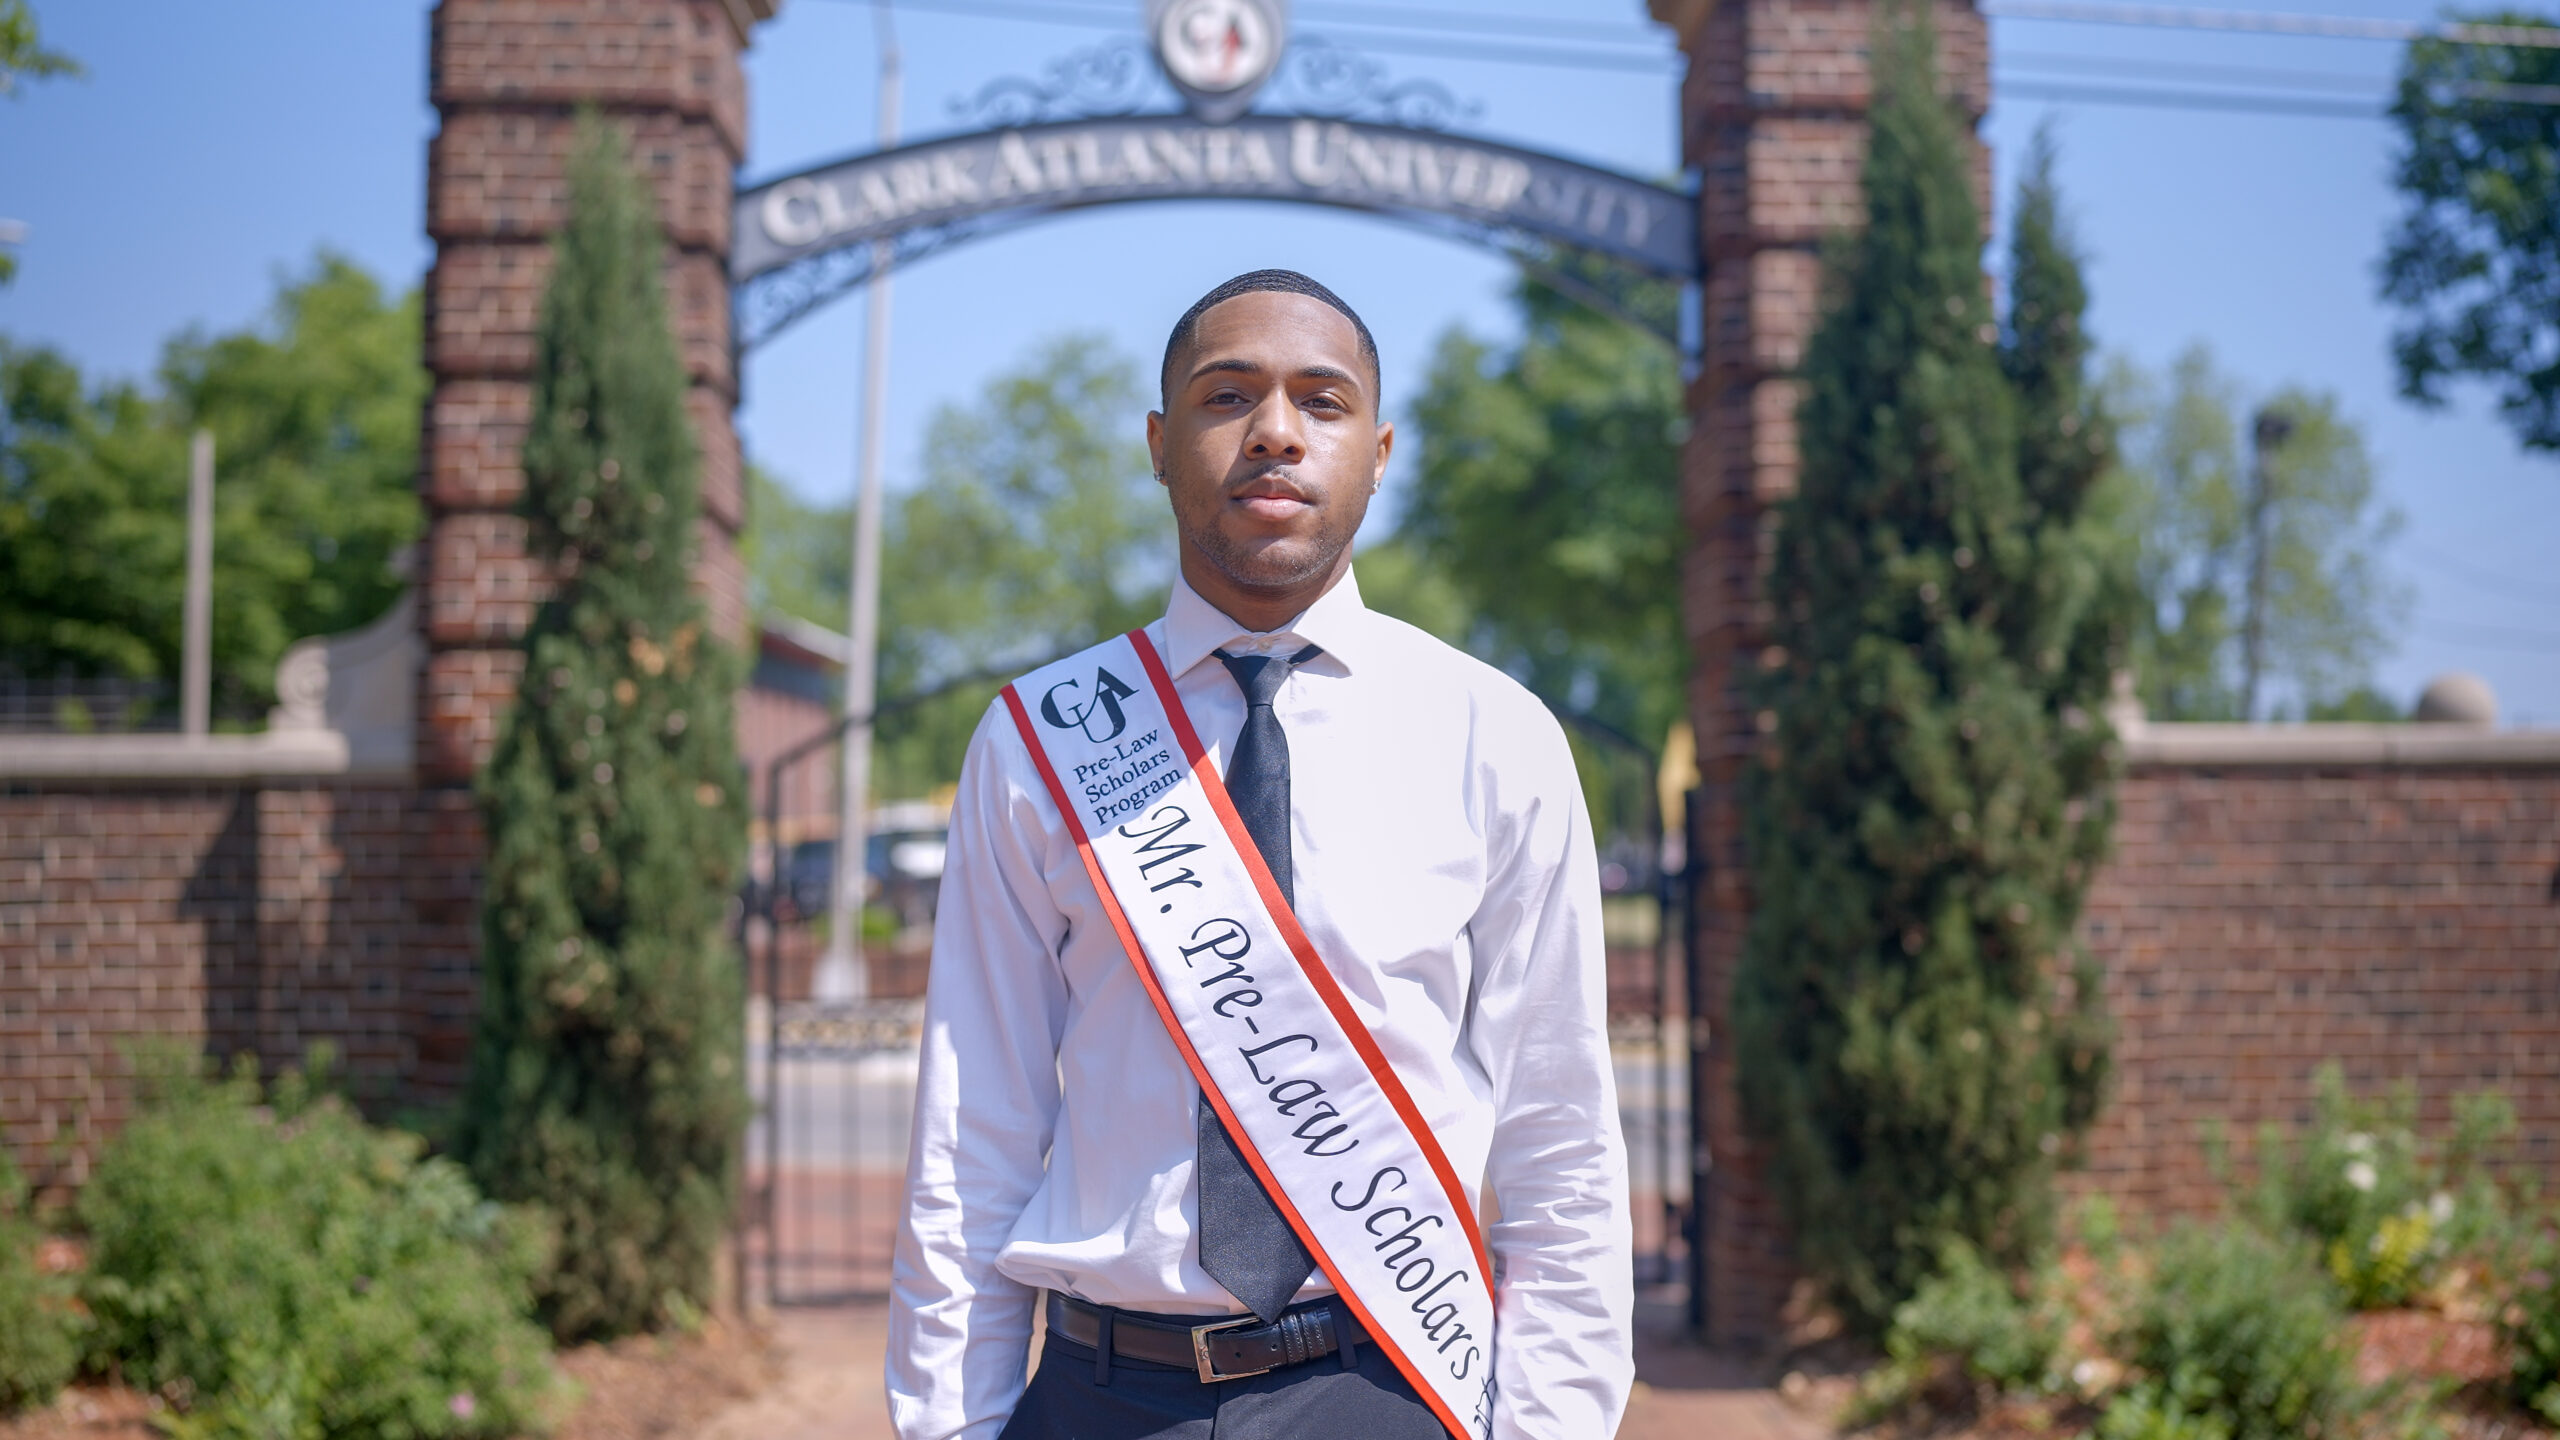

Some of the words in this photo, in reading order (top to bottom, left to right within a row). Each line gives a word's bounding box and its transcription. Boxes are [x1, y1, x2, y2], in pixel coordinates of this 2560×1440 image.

[761, 150, 983, 247] CLARK
[991, 129, 1274, 198] ATLANTA
[1290, 118, 1664, 249] UNIVERSITY
[1073, 729, 1158, 785] Pre-Law
[1085, 749, 1170, 805] Scholars
[1093, 769, 1183, 826] Program
[1118, 805, 1207, 914] Mr.
[1178, 917, 1360, 1157] Pre-Law
[1330, 1166, 1480, 1381] Scholars
